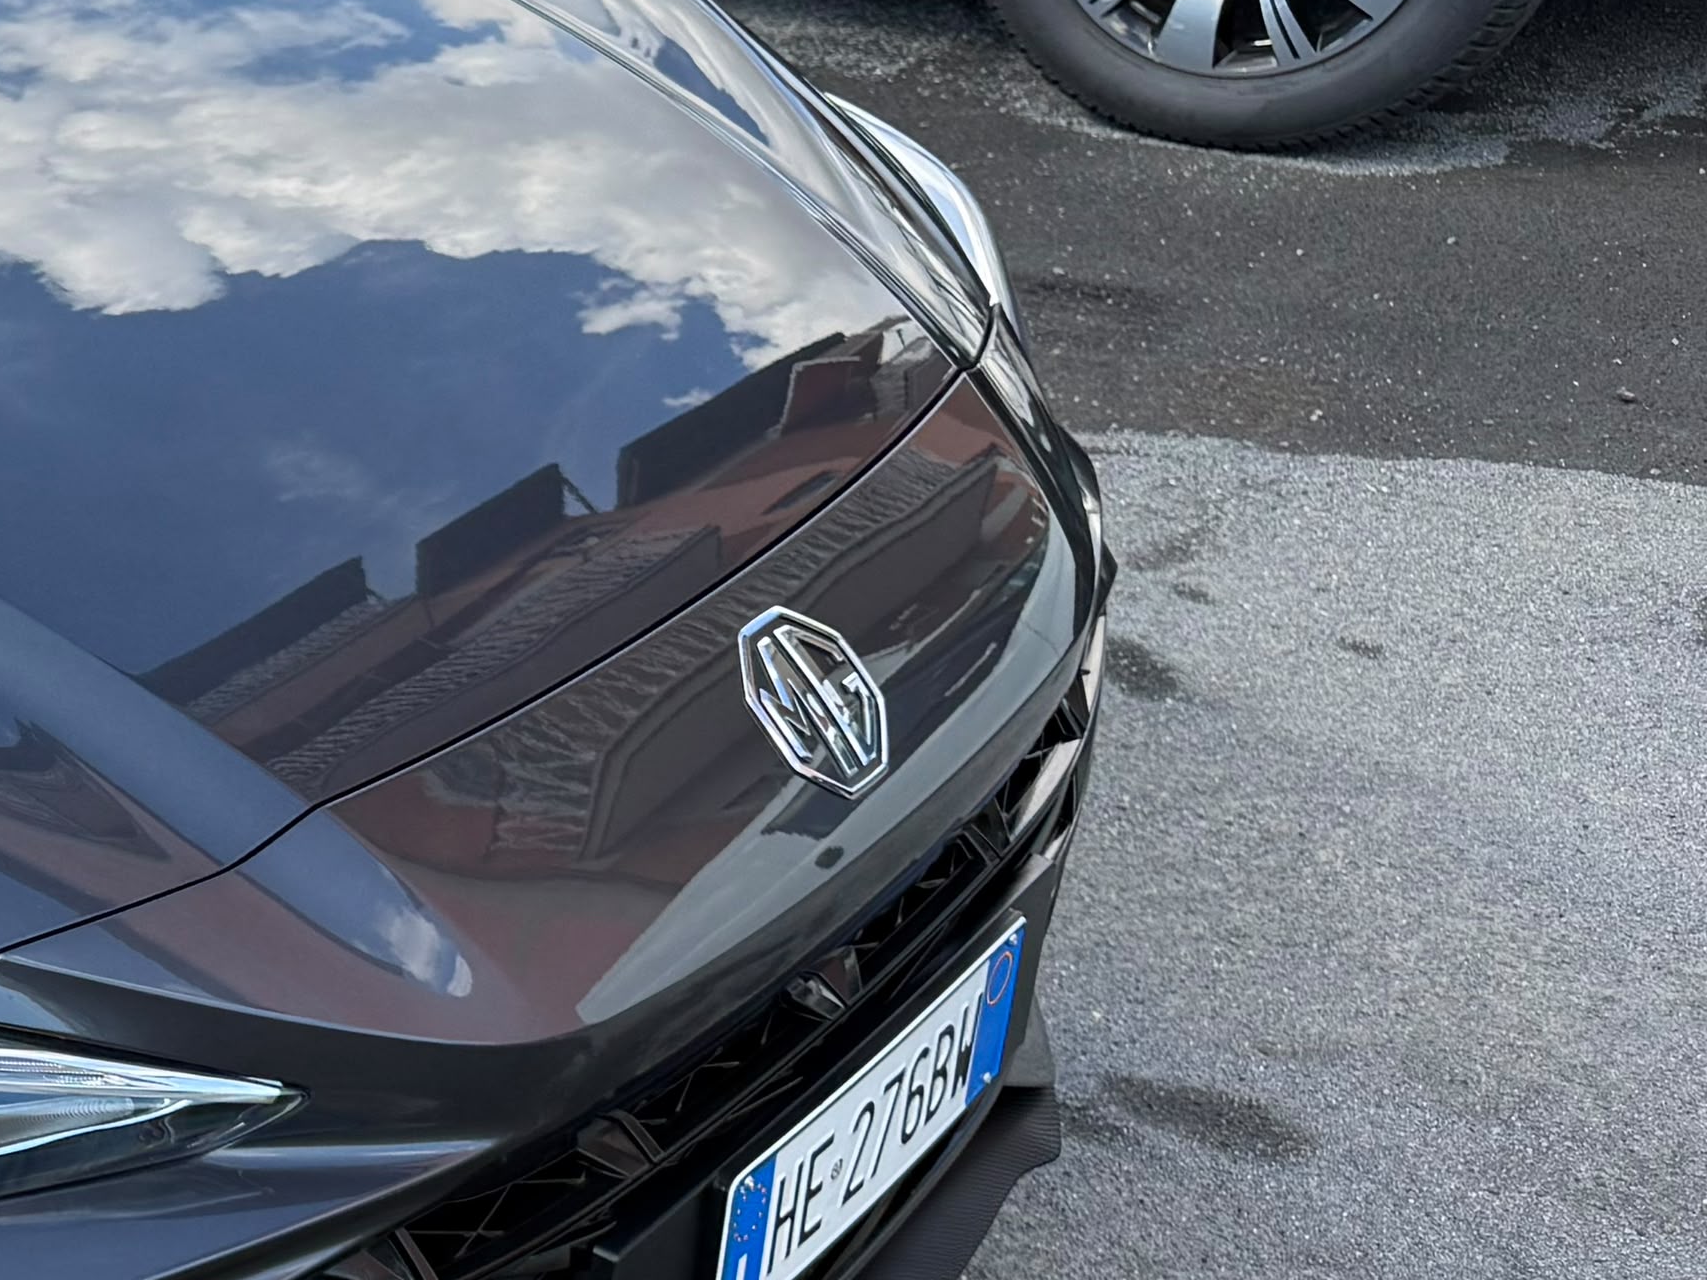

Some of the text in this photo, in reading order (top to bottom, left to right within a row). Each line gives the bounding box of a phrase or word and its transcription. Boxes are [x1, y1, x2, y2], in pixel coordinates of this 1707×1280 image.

[756, 623, 877, 778] MG
[765, 1131, 836, 1278] HE
[836, 990, 984, 1208] 276BW
